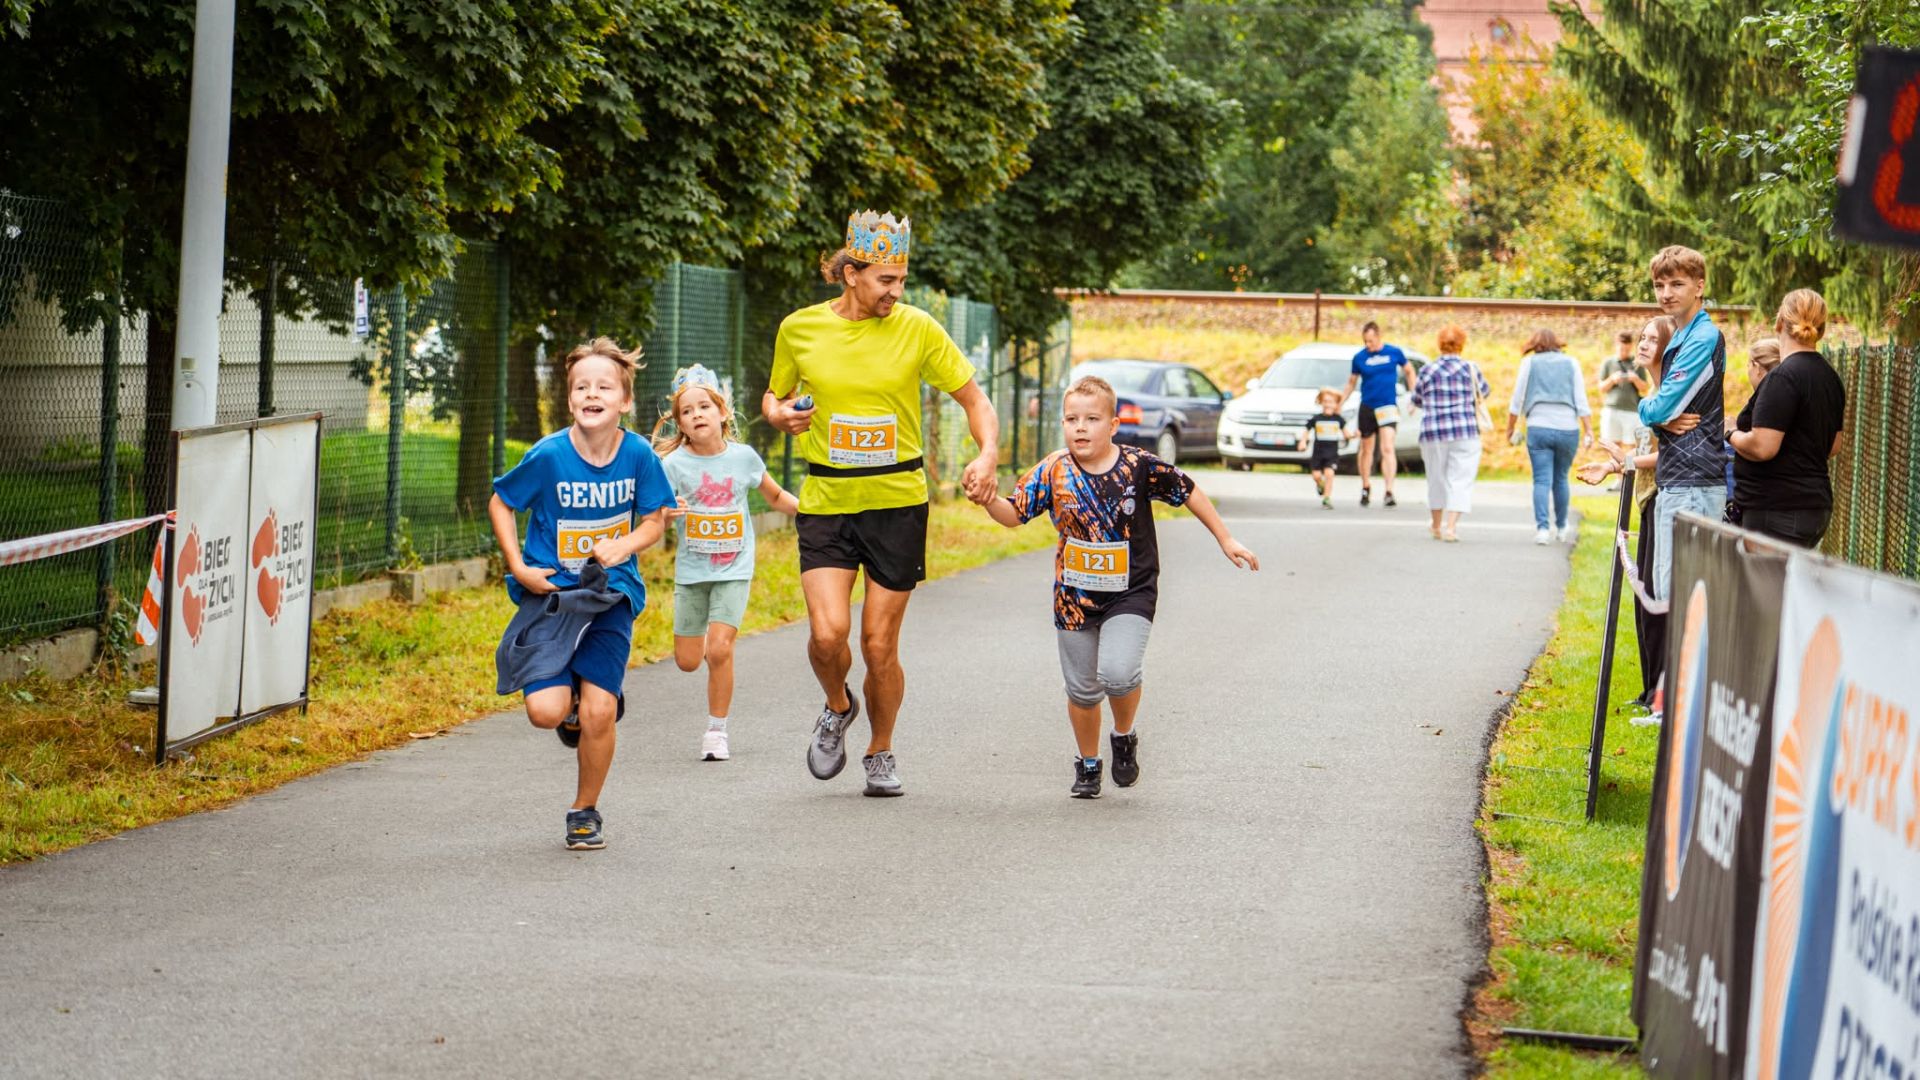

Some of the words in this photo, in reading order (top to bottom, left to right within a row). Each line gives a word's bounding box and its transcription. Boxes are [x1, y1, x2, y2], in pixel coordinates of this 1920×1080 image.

[848, 429, 886, 448] 122
[556, 478, 636, 509] GENIUS
[281, 520, 304, 554] BIEG
[698, 518, 738, 537] 036
[203, 535, 232, 572] BIEG
[1081, 552, 1115, 571] 121
[1834, 680, 1909, 834] SUPER
